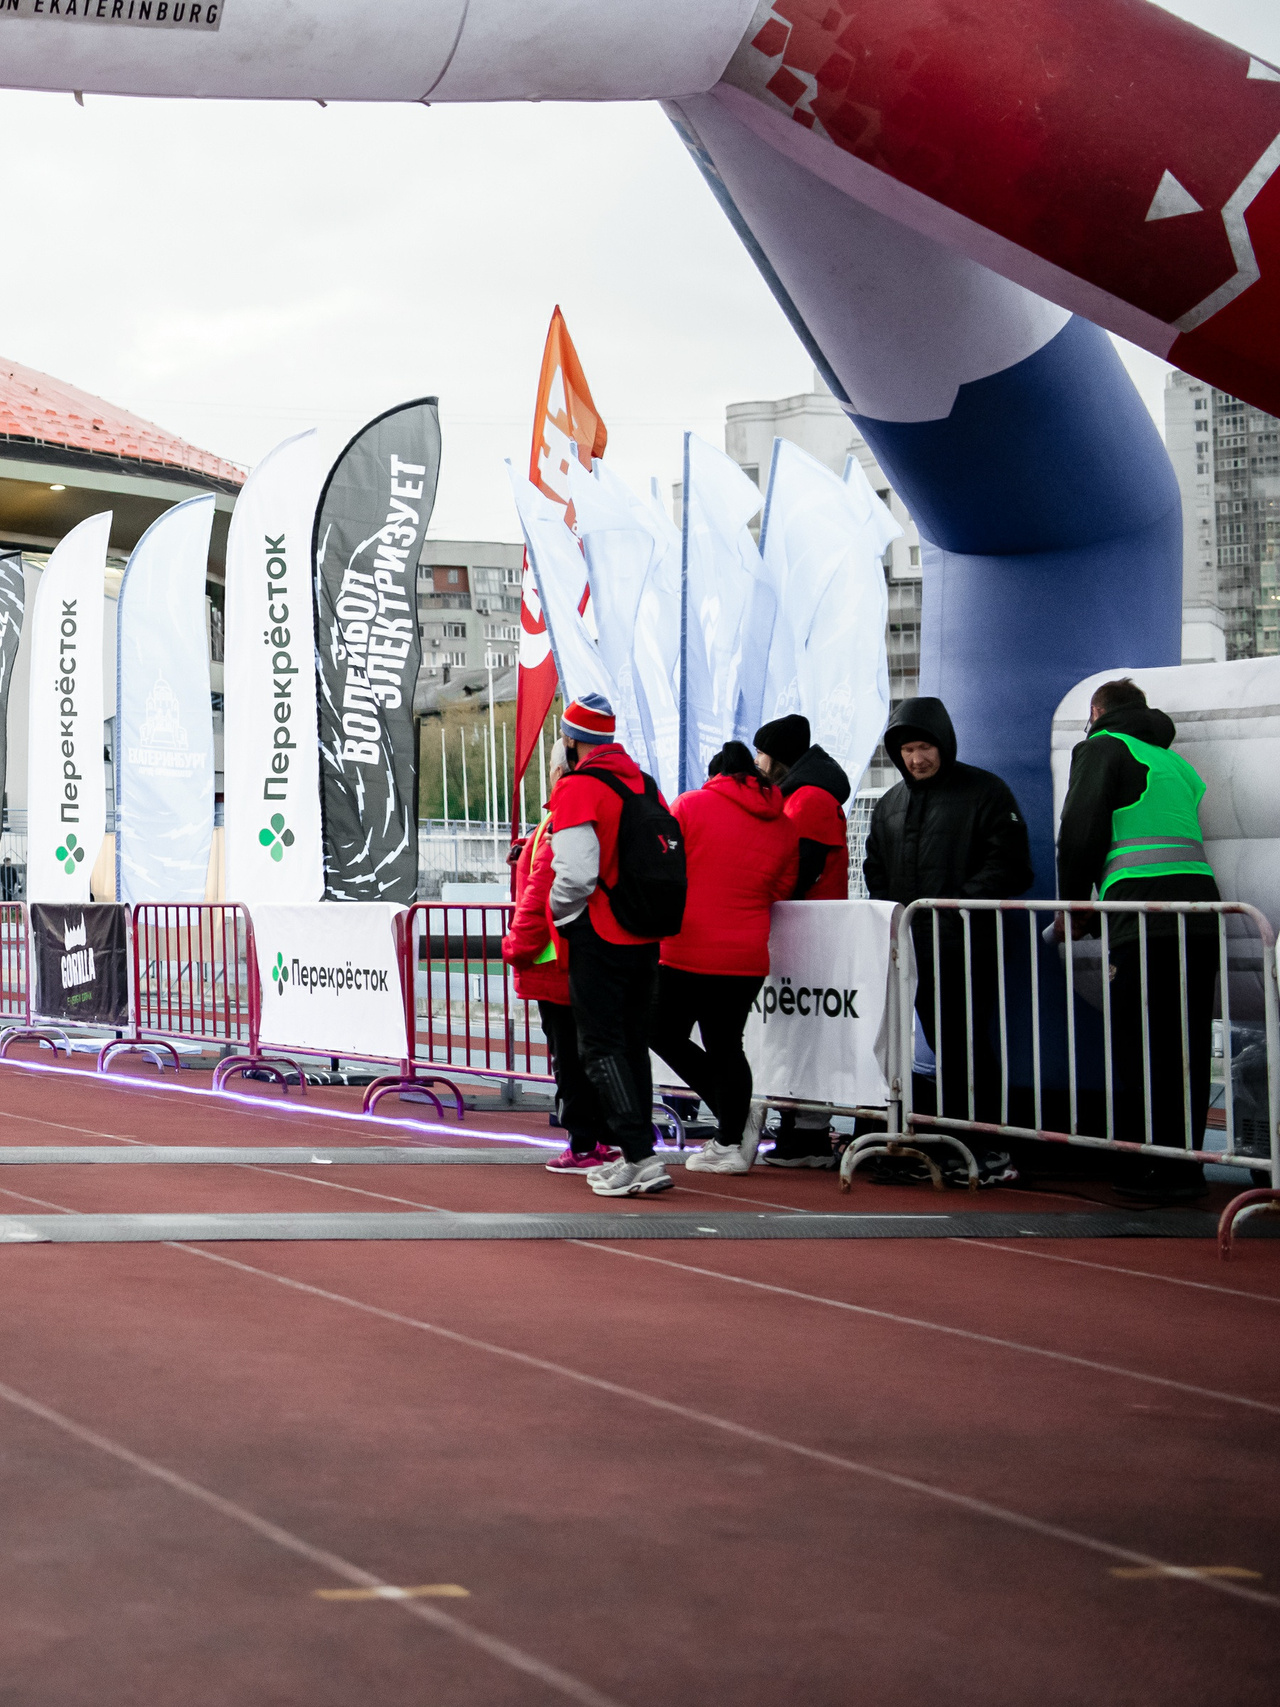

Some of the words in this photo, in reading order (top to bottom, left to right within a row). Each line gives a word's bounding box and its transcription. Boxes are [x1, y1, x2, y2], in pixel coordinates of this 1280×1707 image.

[33, 0, 219, 25] EKATERINBURG
[263, 533, 297, 801] Перекрёсток
[336, 569, 380, 765] ВОЛЕЙБОЛ
[366, 453, 427, 711] ЭЛЕКТРИЗУЕТ
[54, 599, 82, 823] Перекрёсток
[61, 947, 97, 989] GORILLA
[291, 957, 389, 995] Перекрёсток
